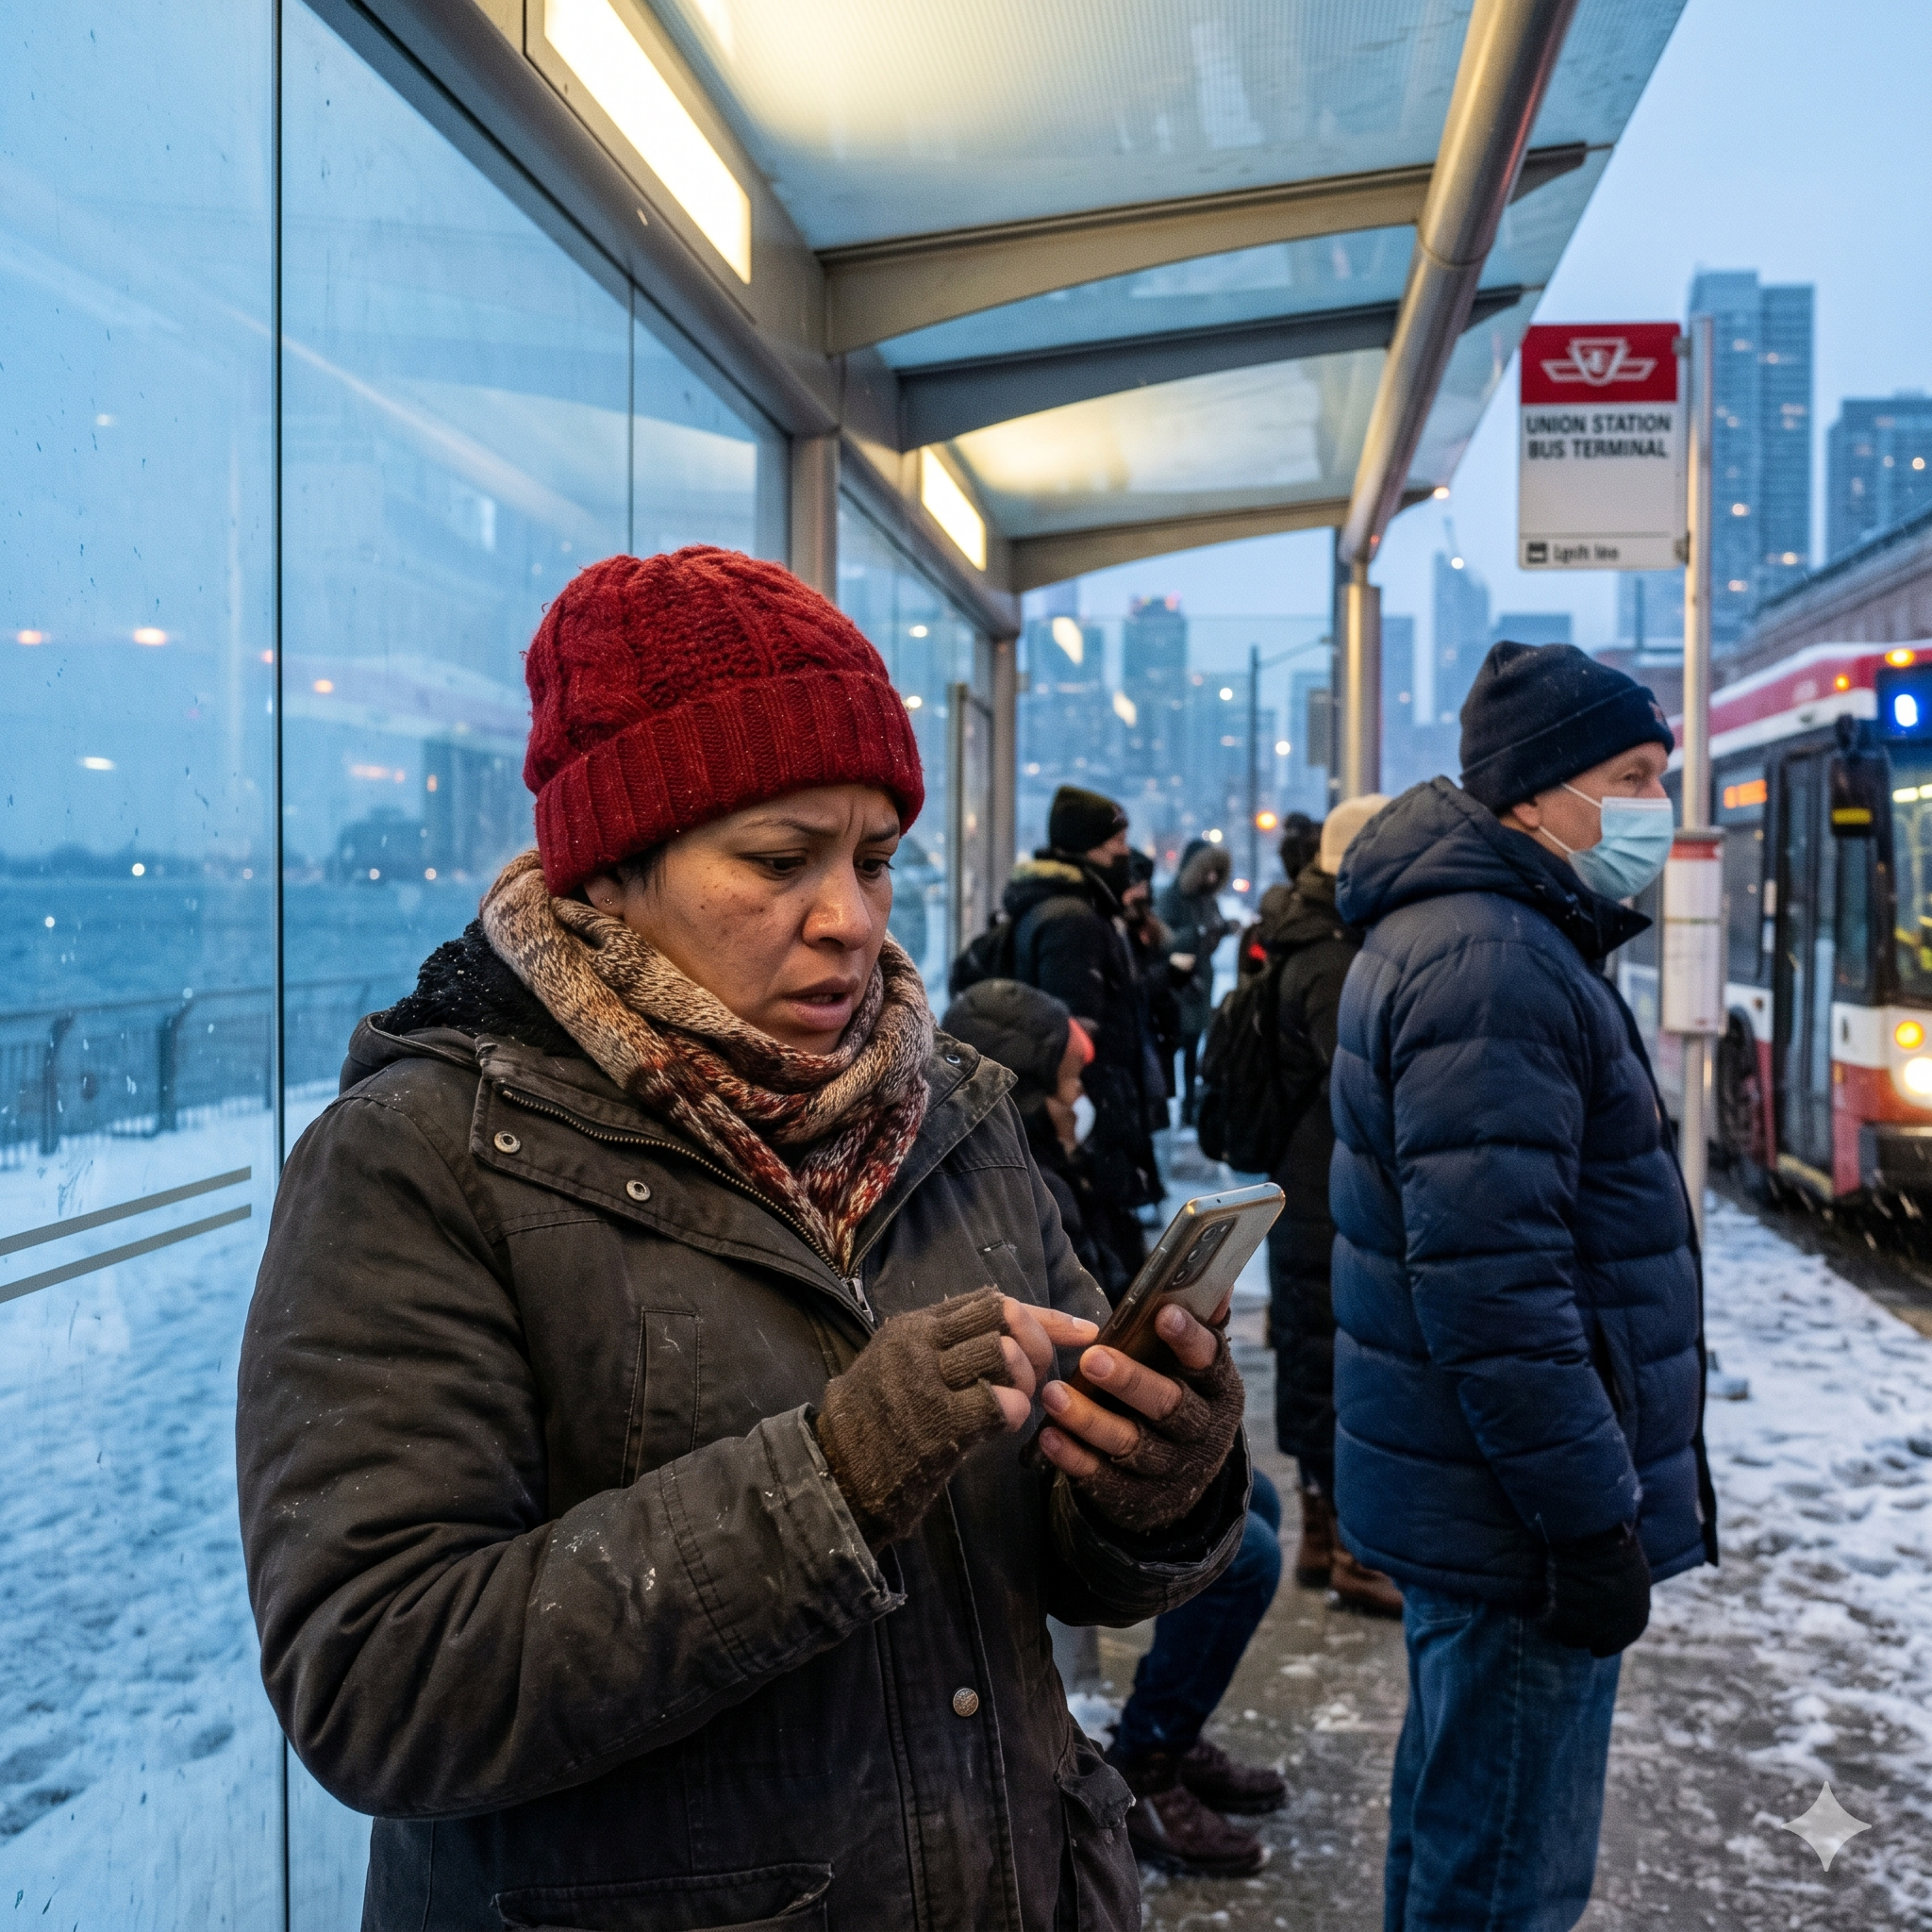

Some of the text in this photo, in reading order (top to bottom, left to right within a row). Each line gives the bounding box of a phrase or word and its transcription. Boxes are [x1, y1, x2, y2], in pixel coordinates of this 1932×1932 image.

[1526, 413, 1671, 434] UNION STATION
[1528, 438, 1667, 459] BUS TERMINAL
